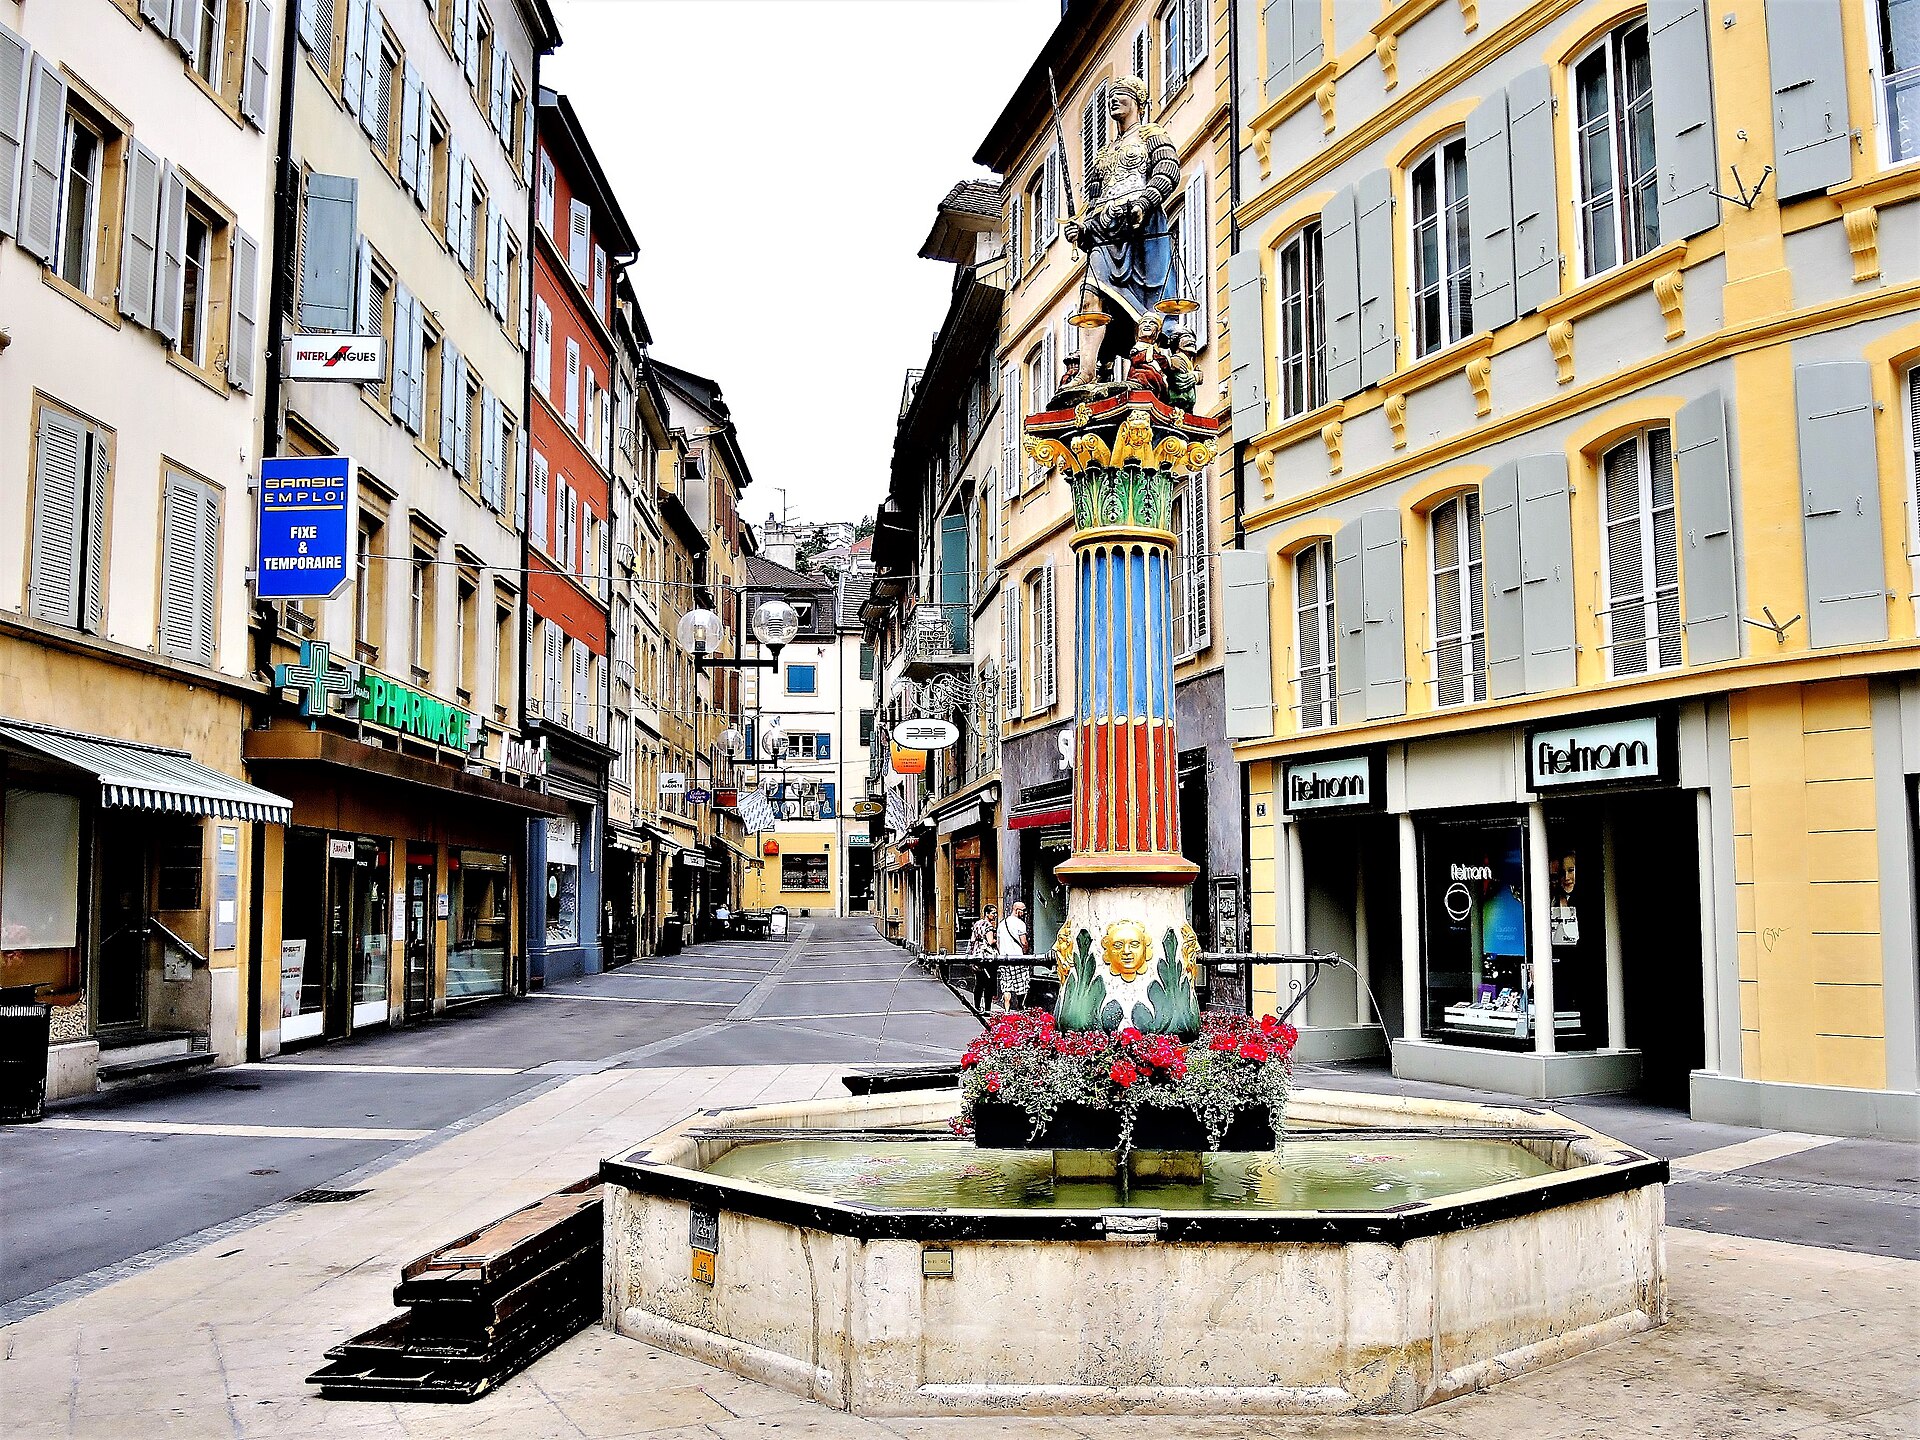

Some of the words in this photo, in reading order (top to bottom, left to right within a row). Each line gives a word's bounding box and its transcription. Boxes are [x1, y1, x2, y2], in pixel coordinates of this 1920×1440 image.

[296, 349, 376, 363] INTERLANGUES
[264, 477, 344, 489] SAMSIC
[264, 490, 344, 503] EMPLOI
[290, 526, 318, 539] FIXE
[298, 541, 308, 554] &
[263, 556, 342, 571] TEMPORAIRE
[373, 677, 470, 750] PHARMACIE
